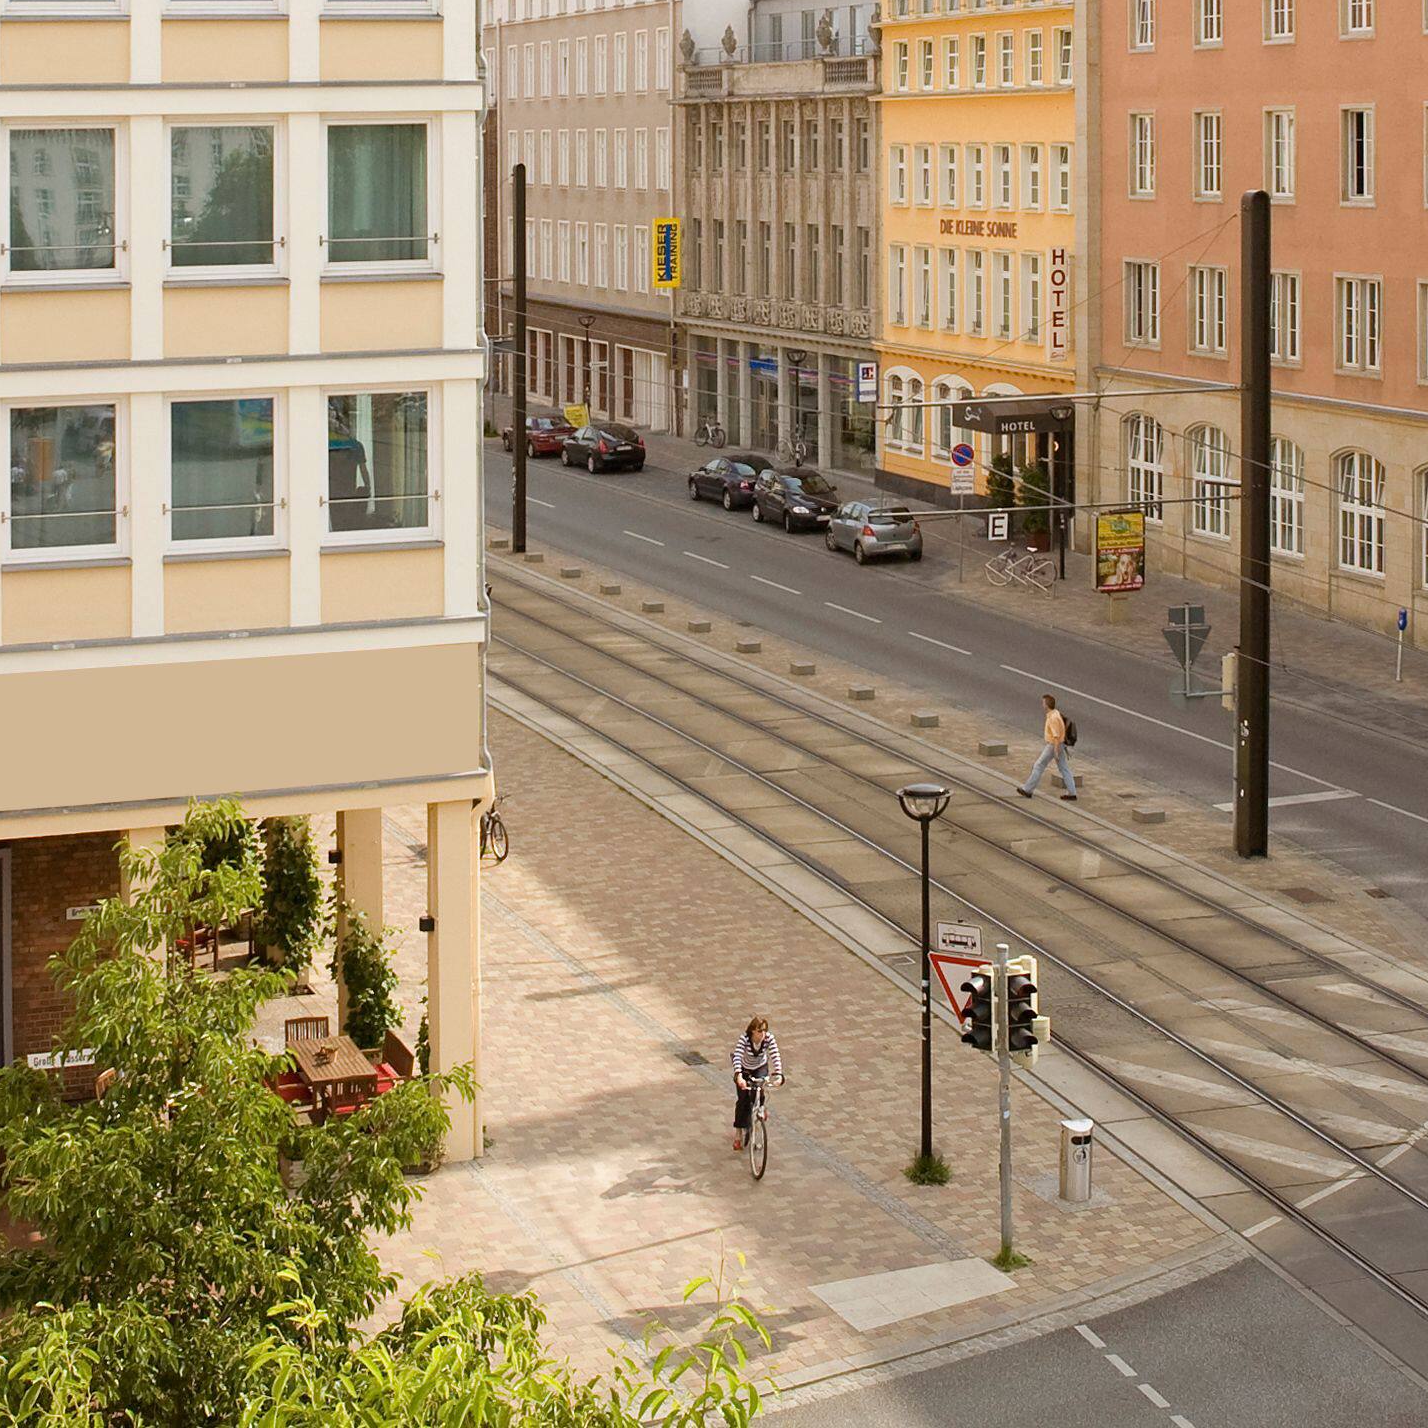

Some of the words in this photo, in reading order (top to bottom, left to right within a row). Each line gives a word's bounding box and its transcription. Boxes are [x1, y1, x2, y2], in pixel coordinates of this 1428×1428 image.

[939, 218, 954, 235] DIE
[955, 219, 985, 237] KLEINE
[986, 220, 1018, 239] SONNE
[657, 223, 672, 282] KIESER
[670, 222, 678, 279] TRAINING
[1051, 248, 1066, 349] HOTEL
[1000, 421, 1036, 432] HOTEL
[991, 515, 1005, 538] E
